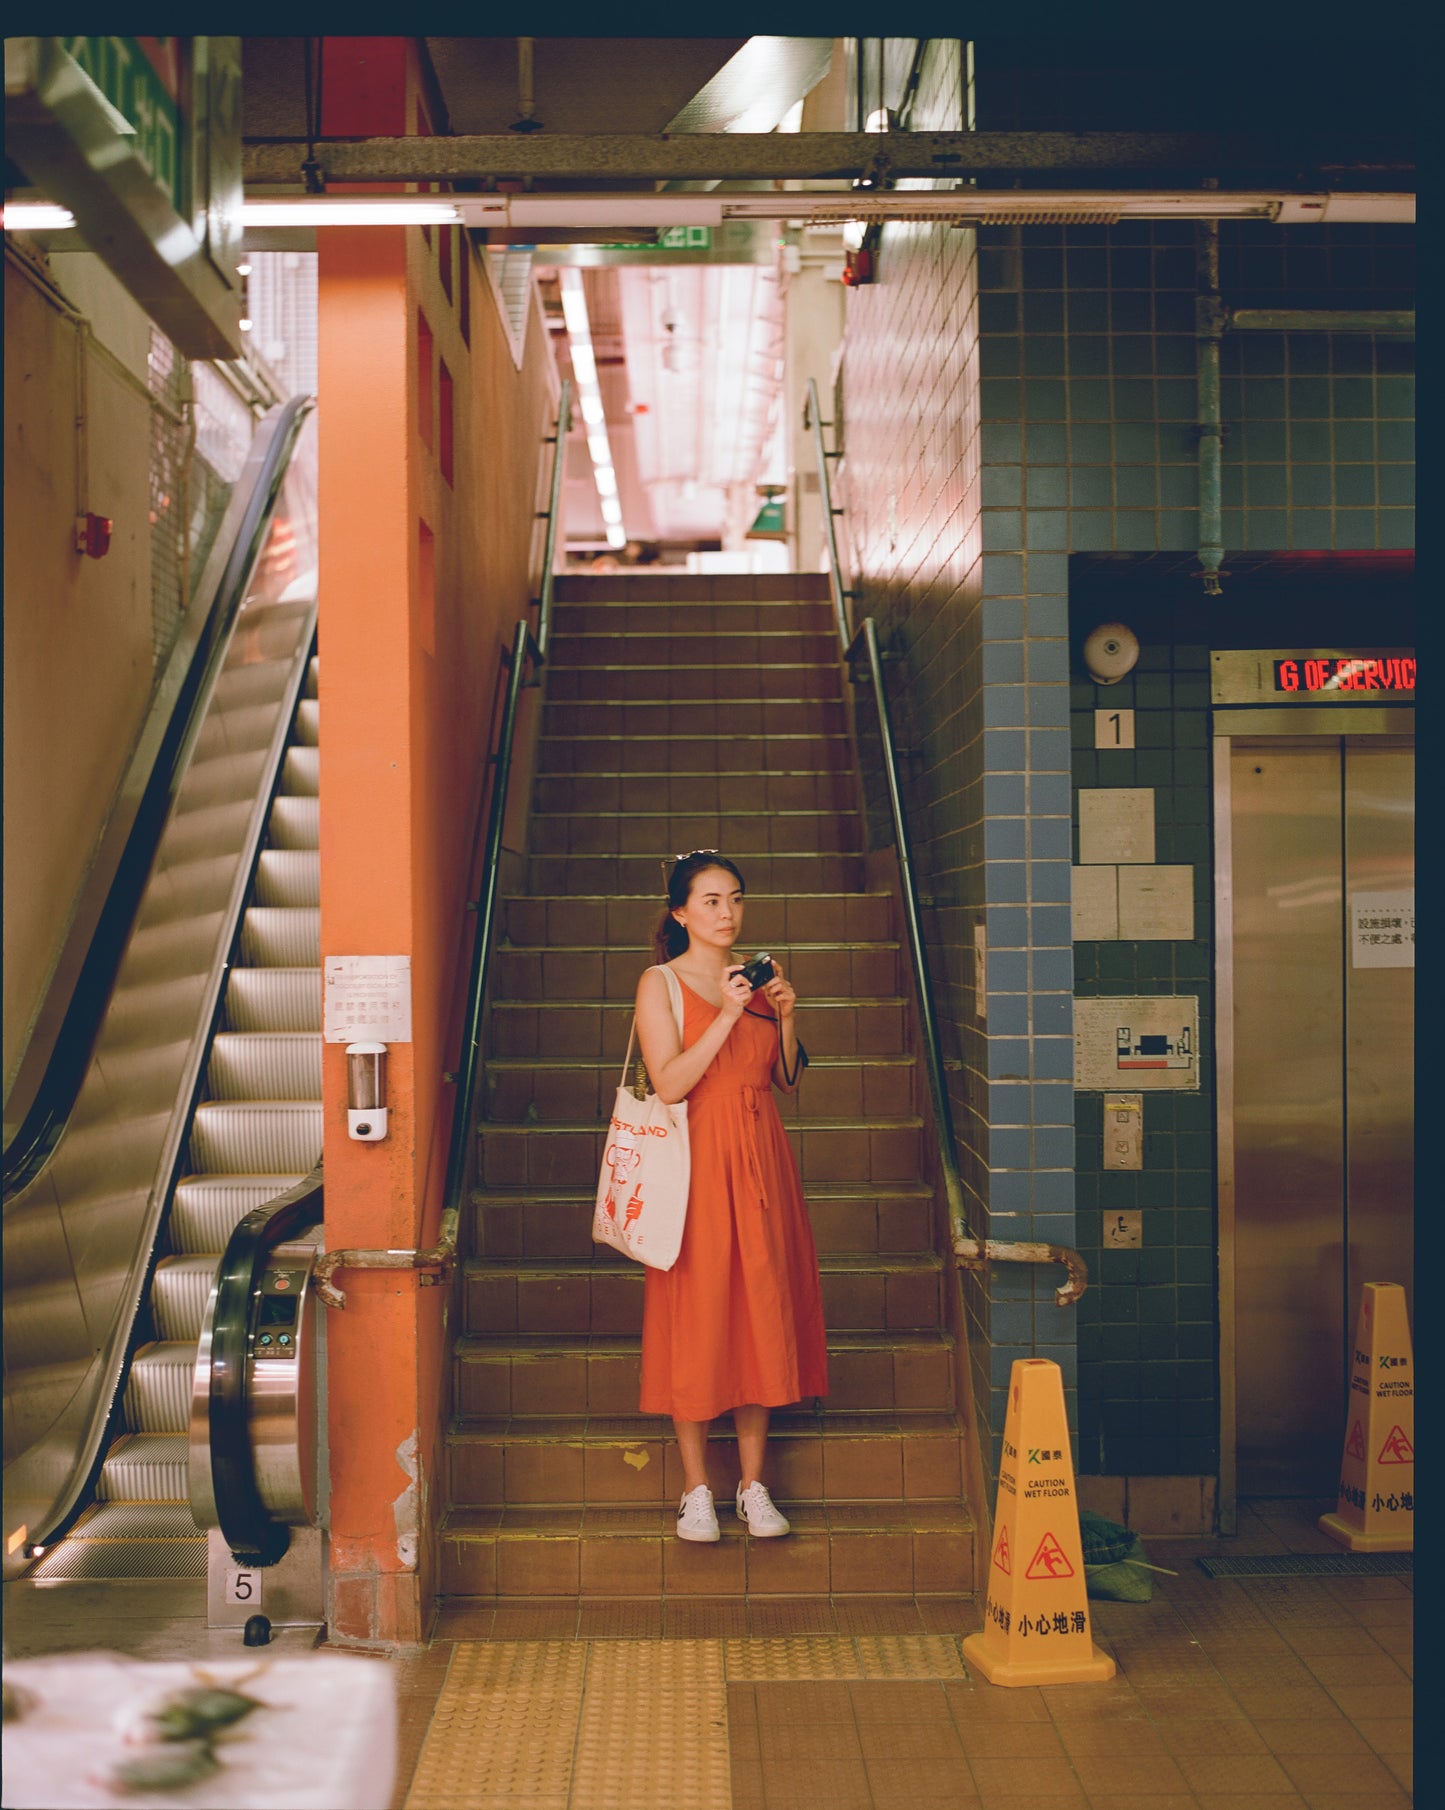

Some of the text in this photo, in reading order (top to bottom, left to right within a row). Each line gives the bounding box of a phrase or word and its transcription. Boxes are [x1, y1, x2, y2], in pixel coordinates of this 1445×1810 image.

[1304, 659, 1330, 691] OF
[1337, 658, 1416, 691] SERVIC
[1109, 713, 1120, 745] 1
[1024, 1488, 1070, 1498] WET FLOOR
[1028, 1479, 1065, 1488] CAUTION
[235, 1573, 252, 1600] 5
[1018, 1611, 1086, 1637] 小心地滑
